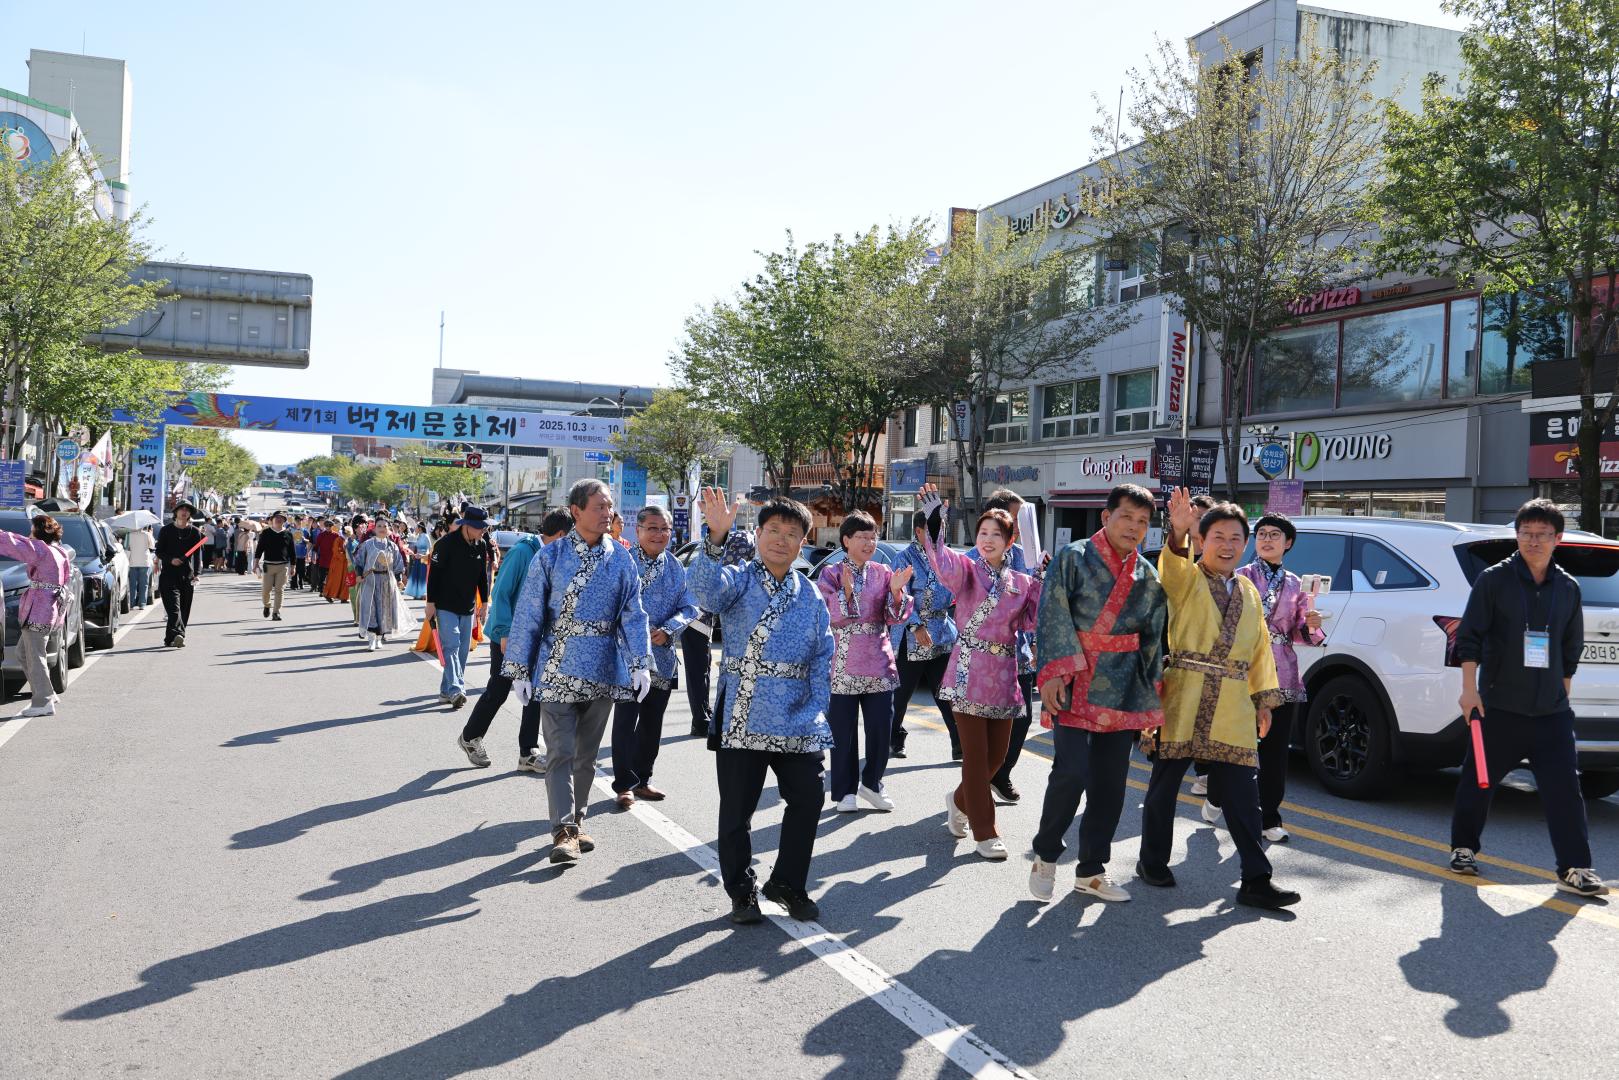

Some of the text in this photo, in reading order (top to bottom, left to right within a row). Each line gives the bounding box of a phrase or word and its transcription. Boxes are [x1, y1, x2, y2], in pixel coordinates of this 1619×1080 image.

[1169, 331, 1187, 414] Mr.Pizza
[286, 407, 337, 425] 제71회
[347, 405, 517, 438] 백제문화제
[539, 419, 587, 432] 2025.10.3
[58, 449, 76, 457] 정산기
[1321, 434, 1392, 461] YOUNG
[1263, 450, 1285, 459] 주차요금
[470, 457, 478, 465] 40
[1113, 454, 1134, 475] cha
[1262, 458, 1284, 469] 정산기
[1190, 486, 1209, 495] 2025
